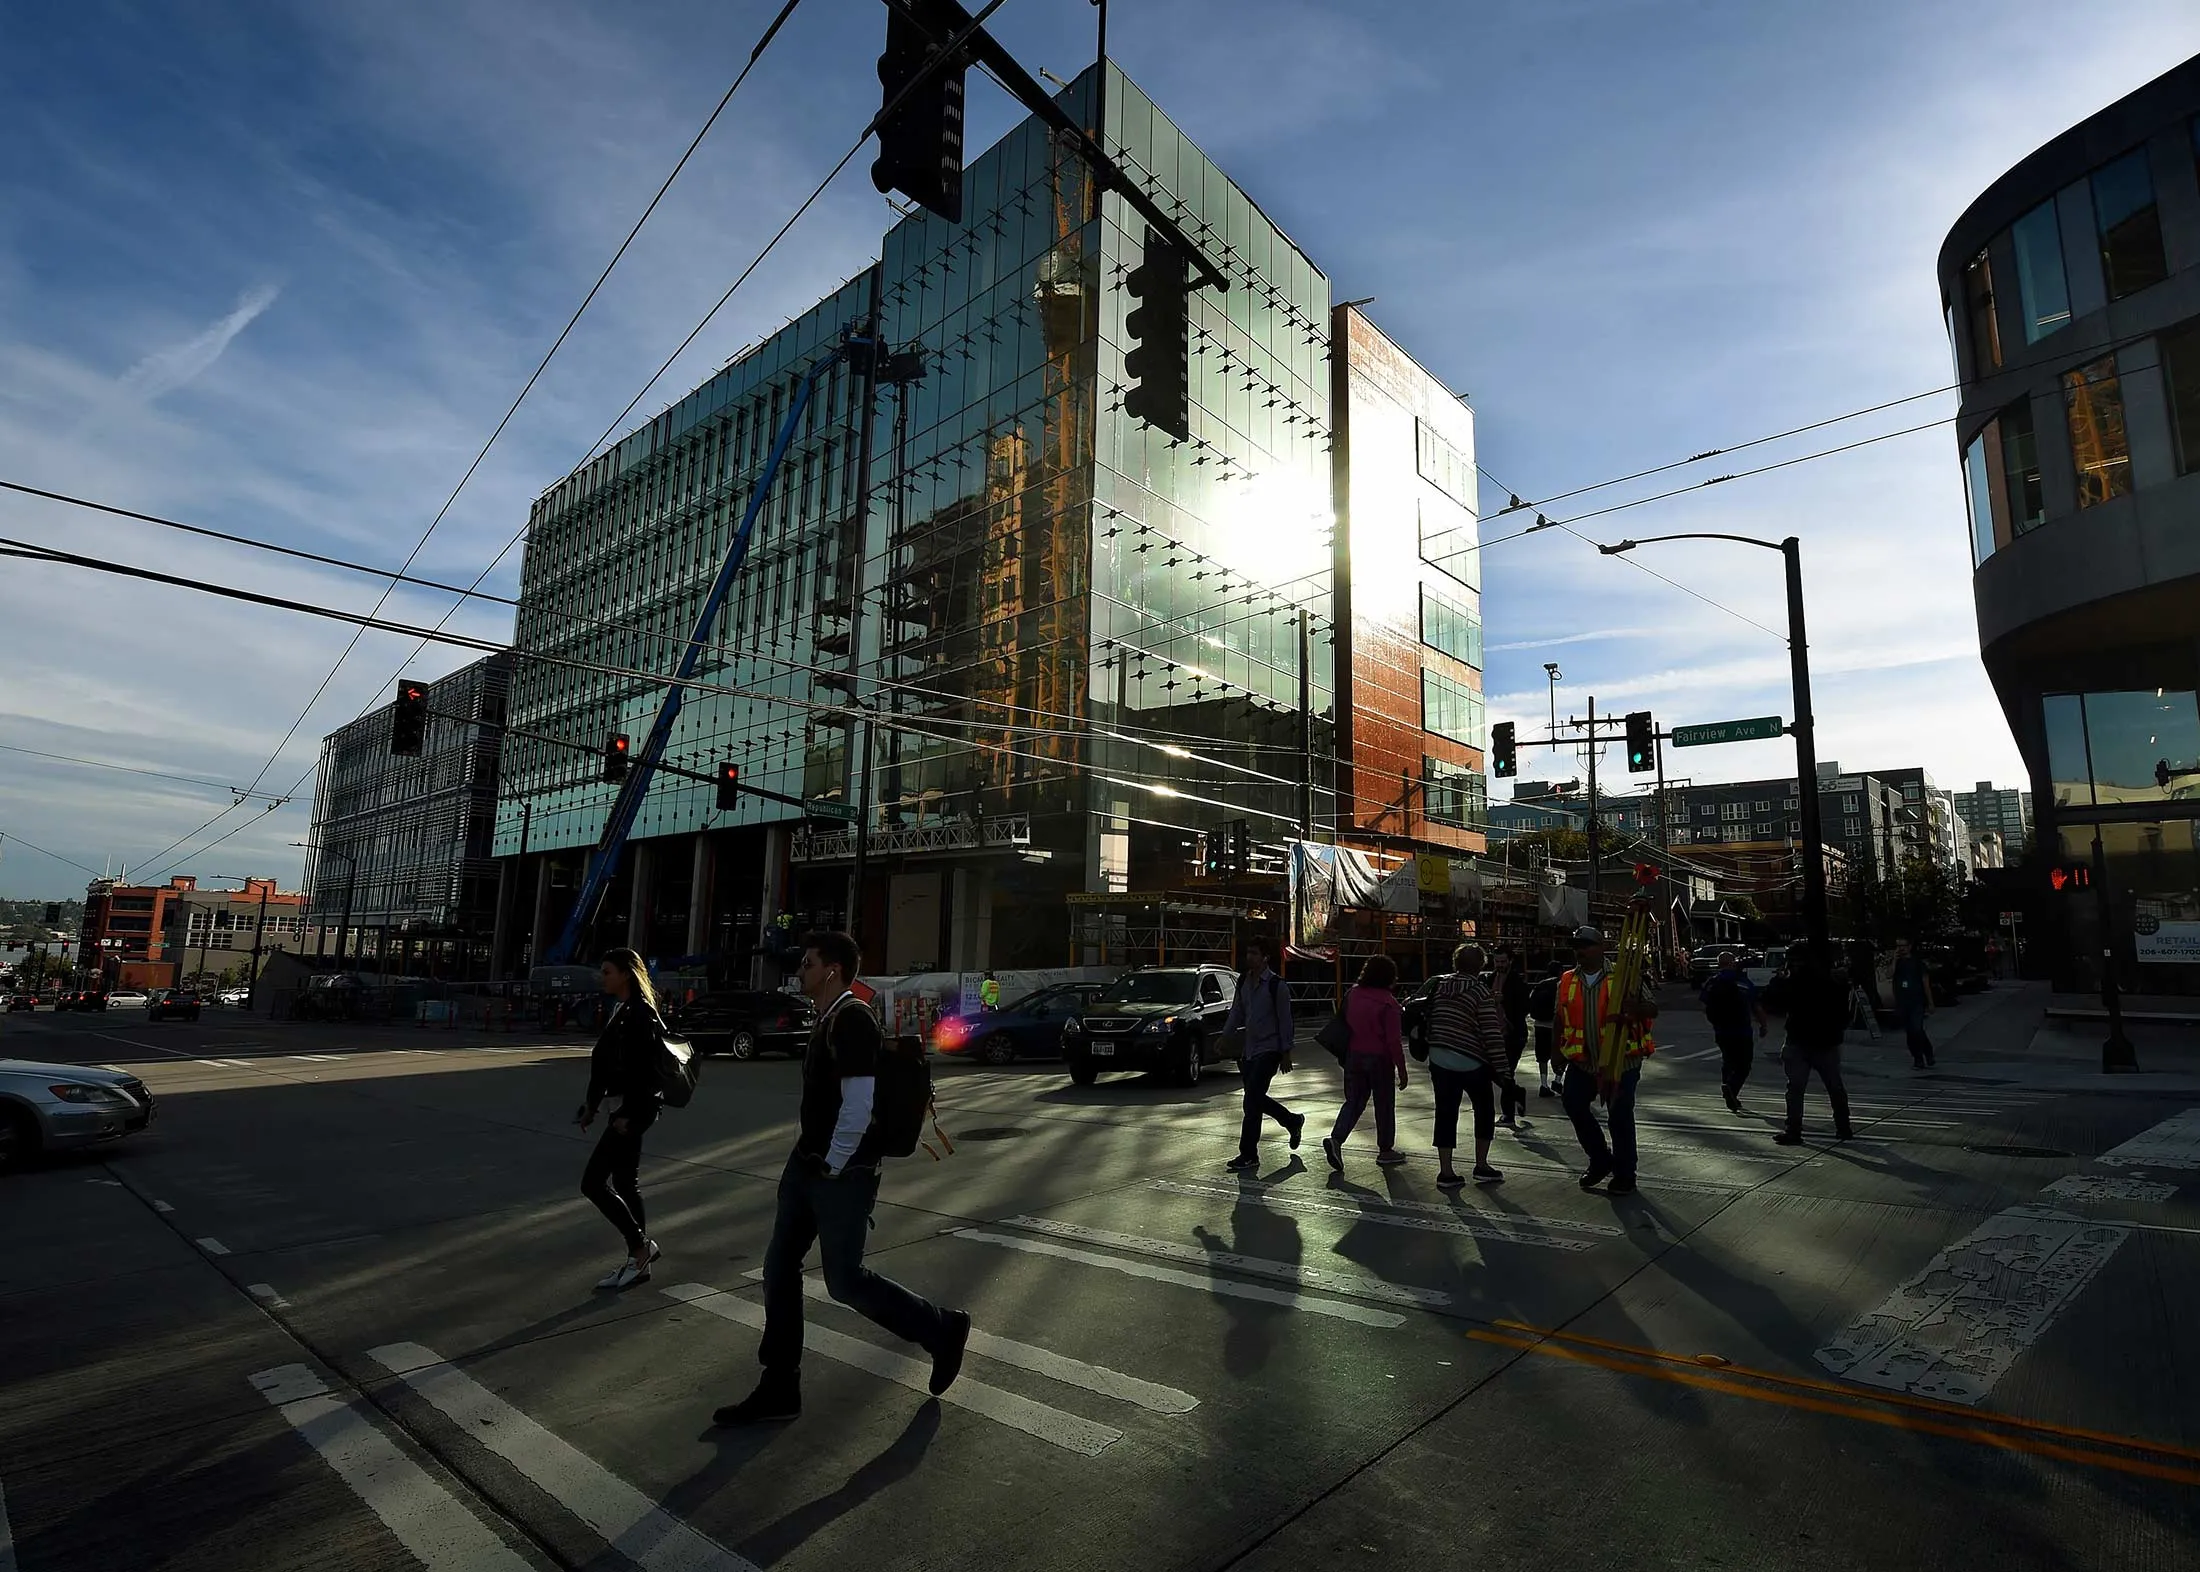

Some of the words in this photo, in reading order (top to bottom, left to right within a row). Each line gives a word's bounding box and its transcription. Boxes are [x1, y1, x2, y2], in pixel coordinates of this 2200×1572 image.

[1676, 727, 1726, 743] Fairview
[1735, 726, 1755, 737] Ave
[1770, 722, 1778, 733] N
[2074, 869, 2088, 886] 11
[2156, 937, 2199, 945] RETAIL
